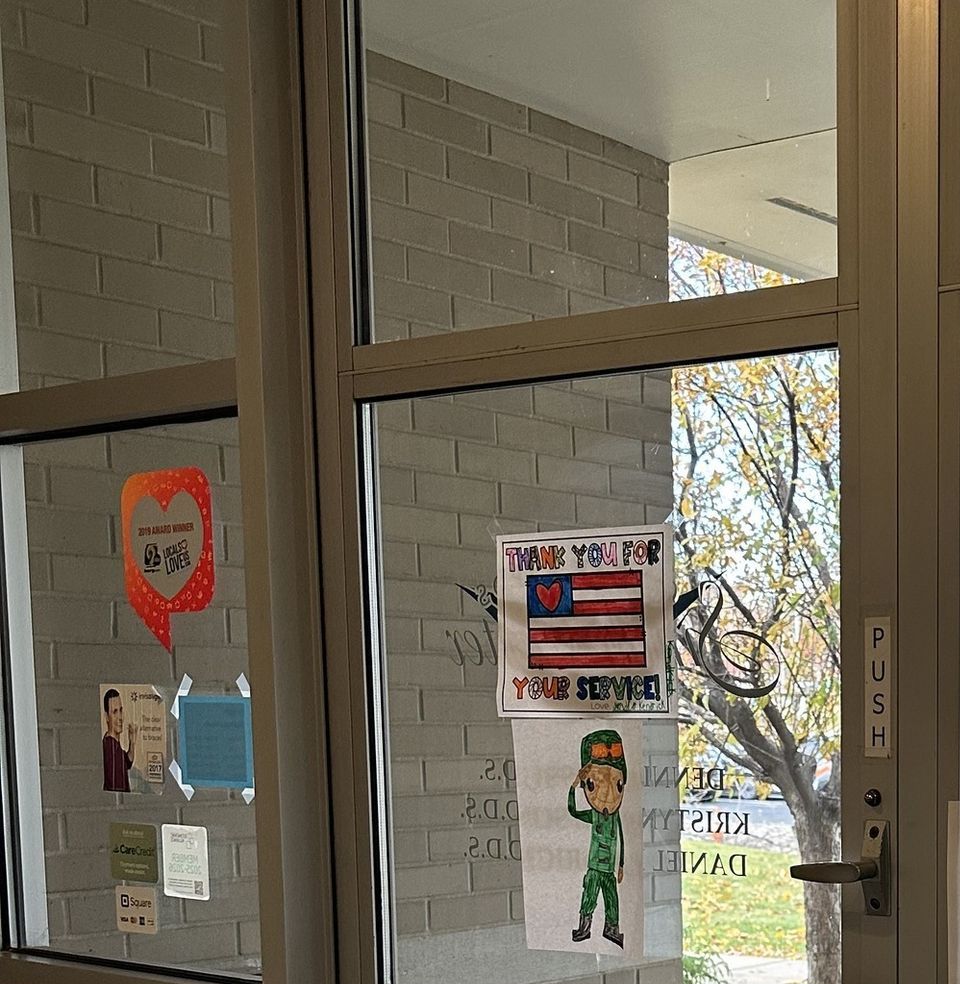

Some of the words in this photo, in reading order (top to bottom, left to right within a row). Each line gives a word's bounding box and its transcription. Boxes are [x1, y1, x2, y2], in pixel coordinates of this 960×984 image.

[152, 525, 171, 535] AWARD
[172, 523, 194, 533] WINNER
[162, 541, 183, 559] LOCALS
[506, 546, 566, 572] THANK
[571, 542, 618, 568] YOU
[622, 539, 661, 566] FOR
[165, 553, 185, 575] LOVE
[512, 676, 570, 700] YOUR
[576, 673, 661, 701] SERVICE!
[872, 627, 885, 747] PUSH
[130, 896, 152, 908] Square
